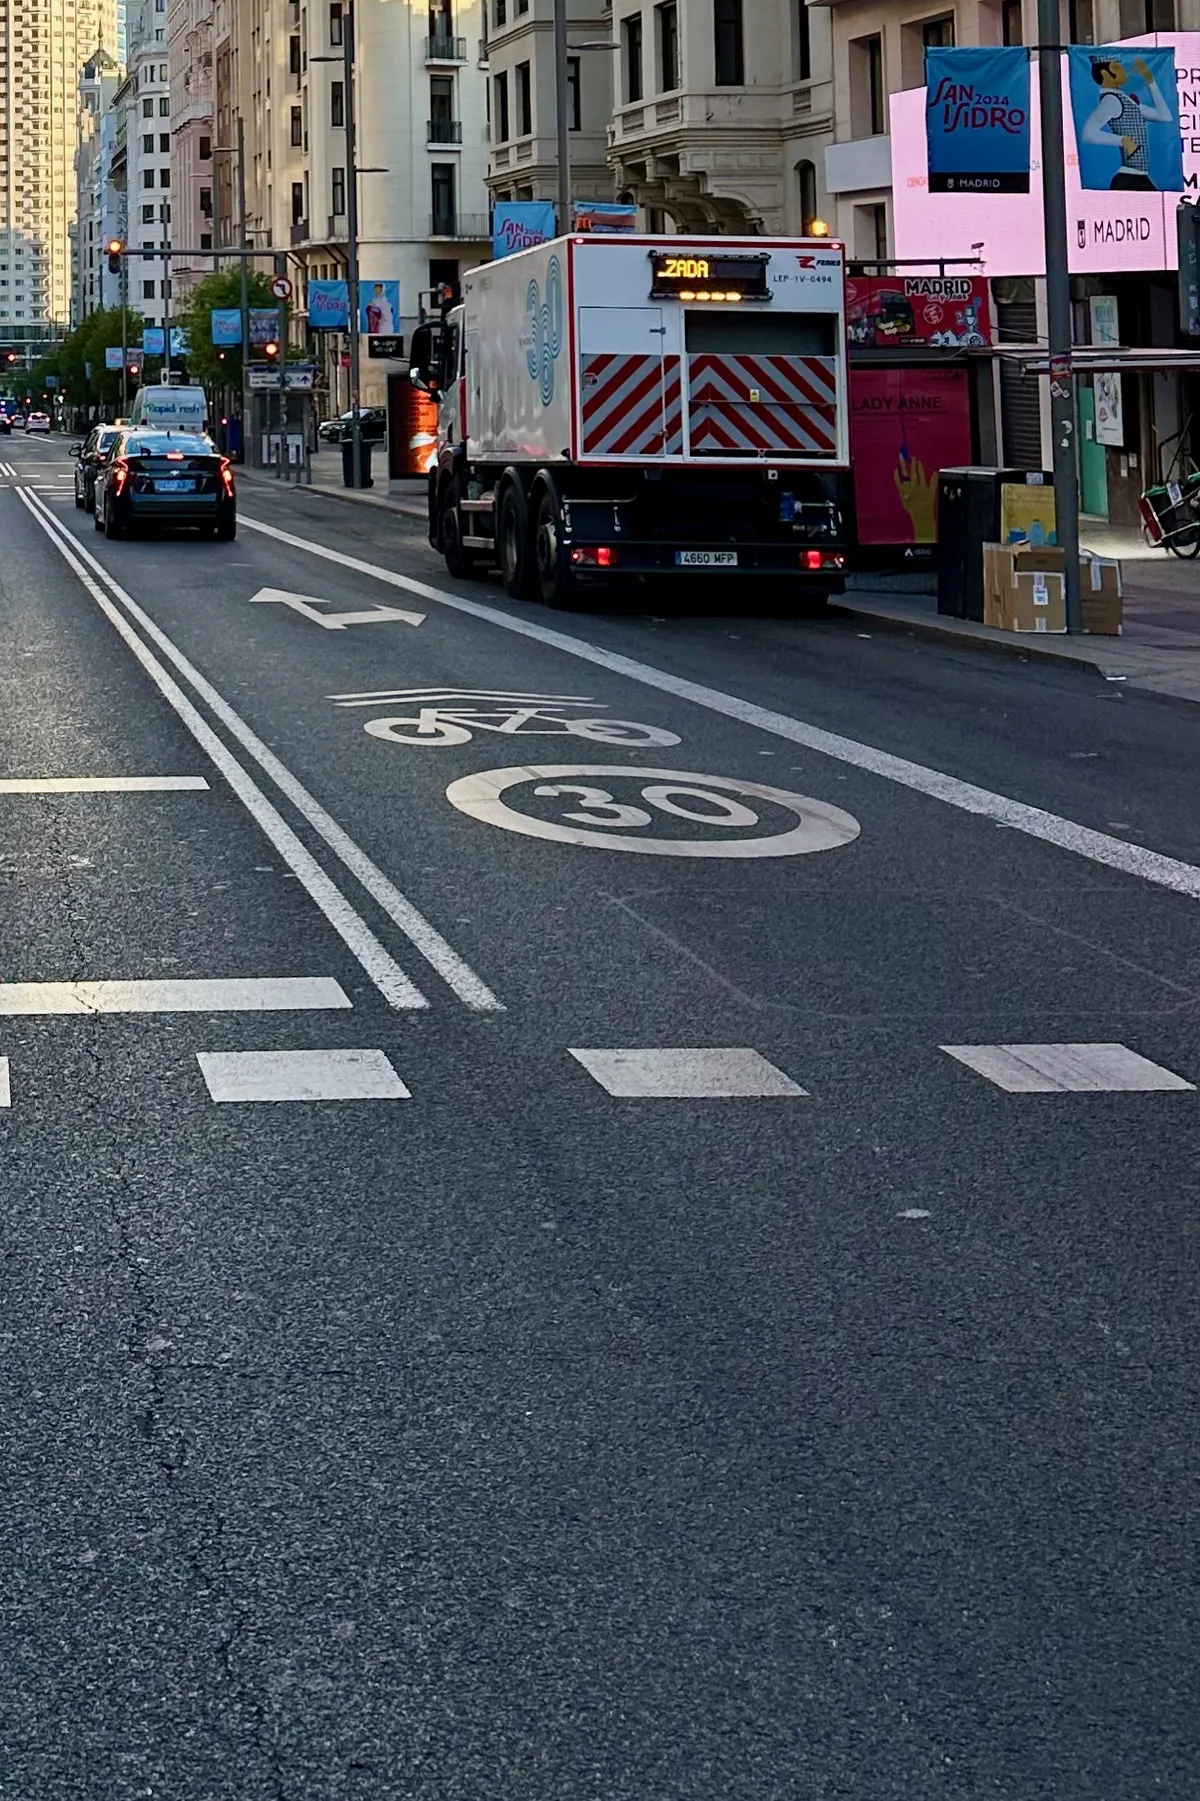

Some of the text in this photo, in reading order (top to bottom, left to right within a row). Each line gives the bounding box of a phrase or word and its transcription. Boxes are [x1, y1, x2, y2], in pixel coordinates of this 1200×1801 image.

[929, 76, 1009, 107] SAN 2024
[944, 107, 1025, 134] ISIDRO
[959, 178, 1000, 188] MADRID
[1093, 217, 1150, 243] MADRID
[905, 279, 972, 296] MADRID
[852, 396, 943, 412] LADY ANNE
[533, 784, 759, 828] 30
